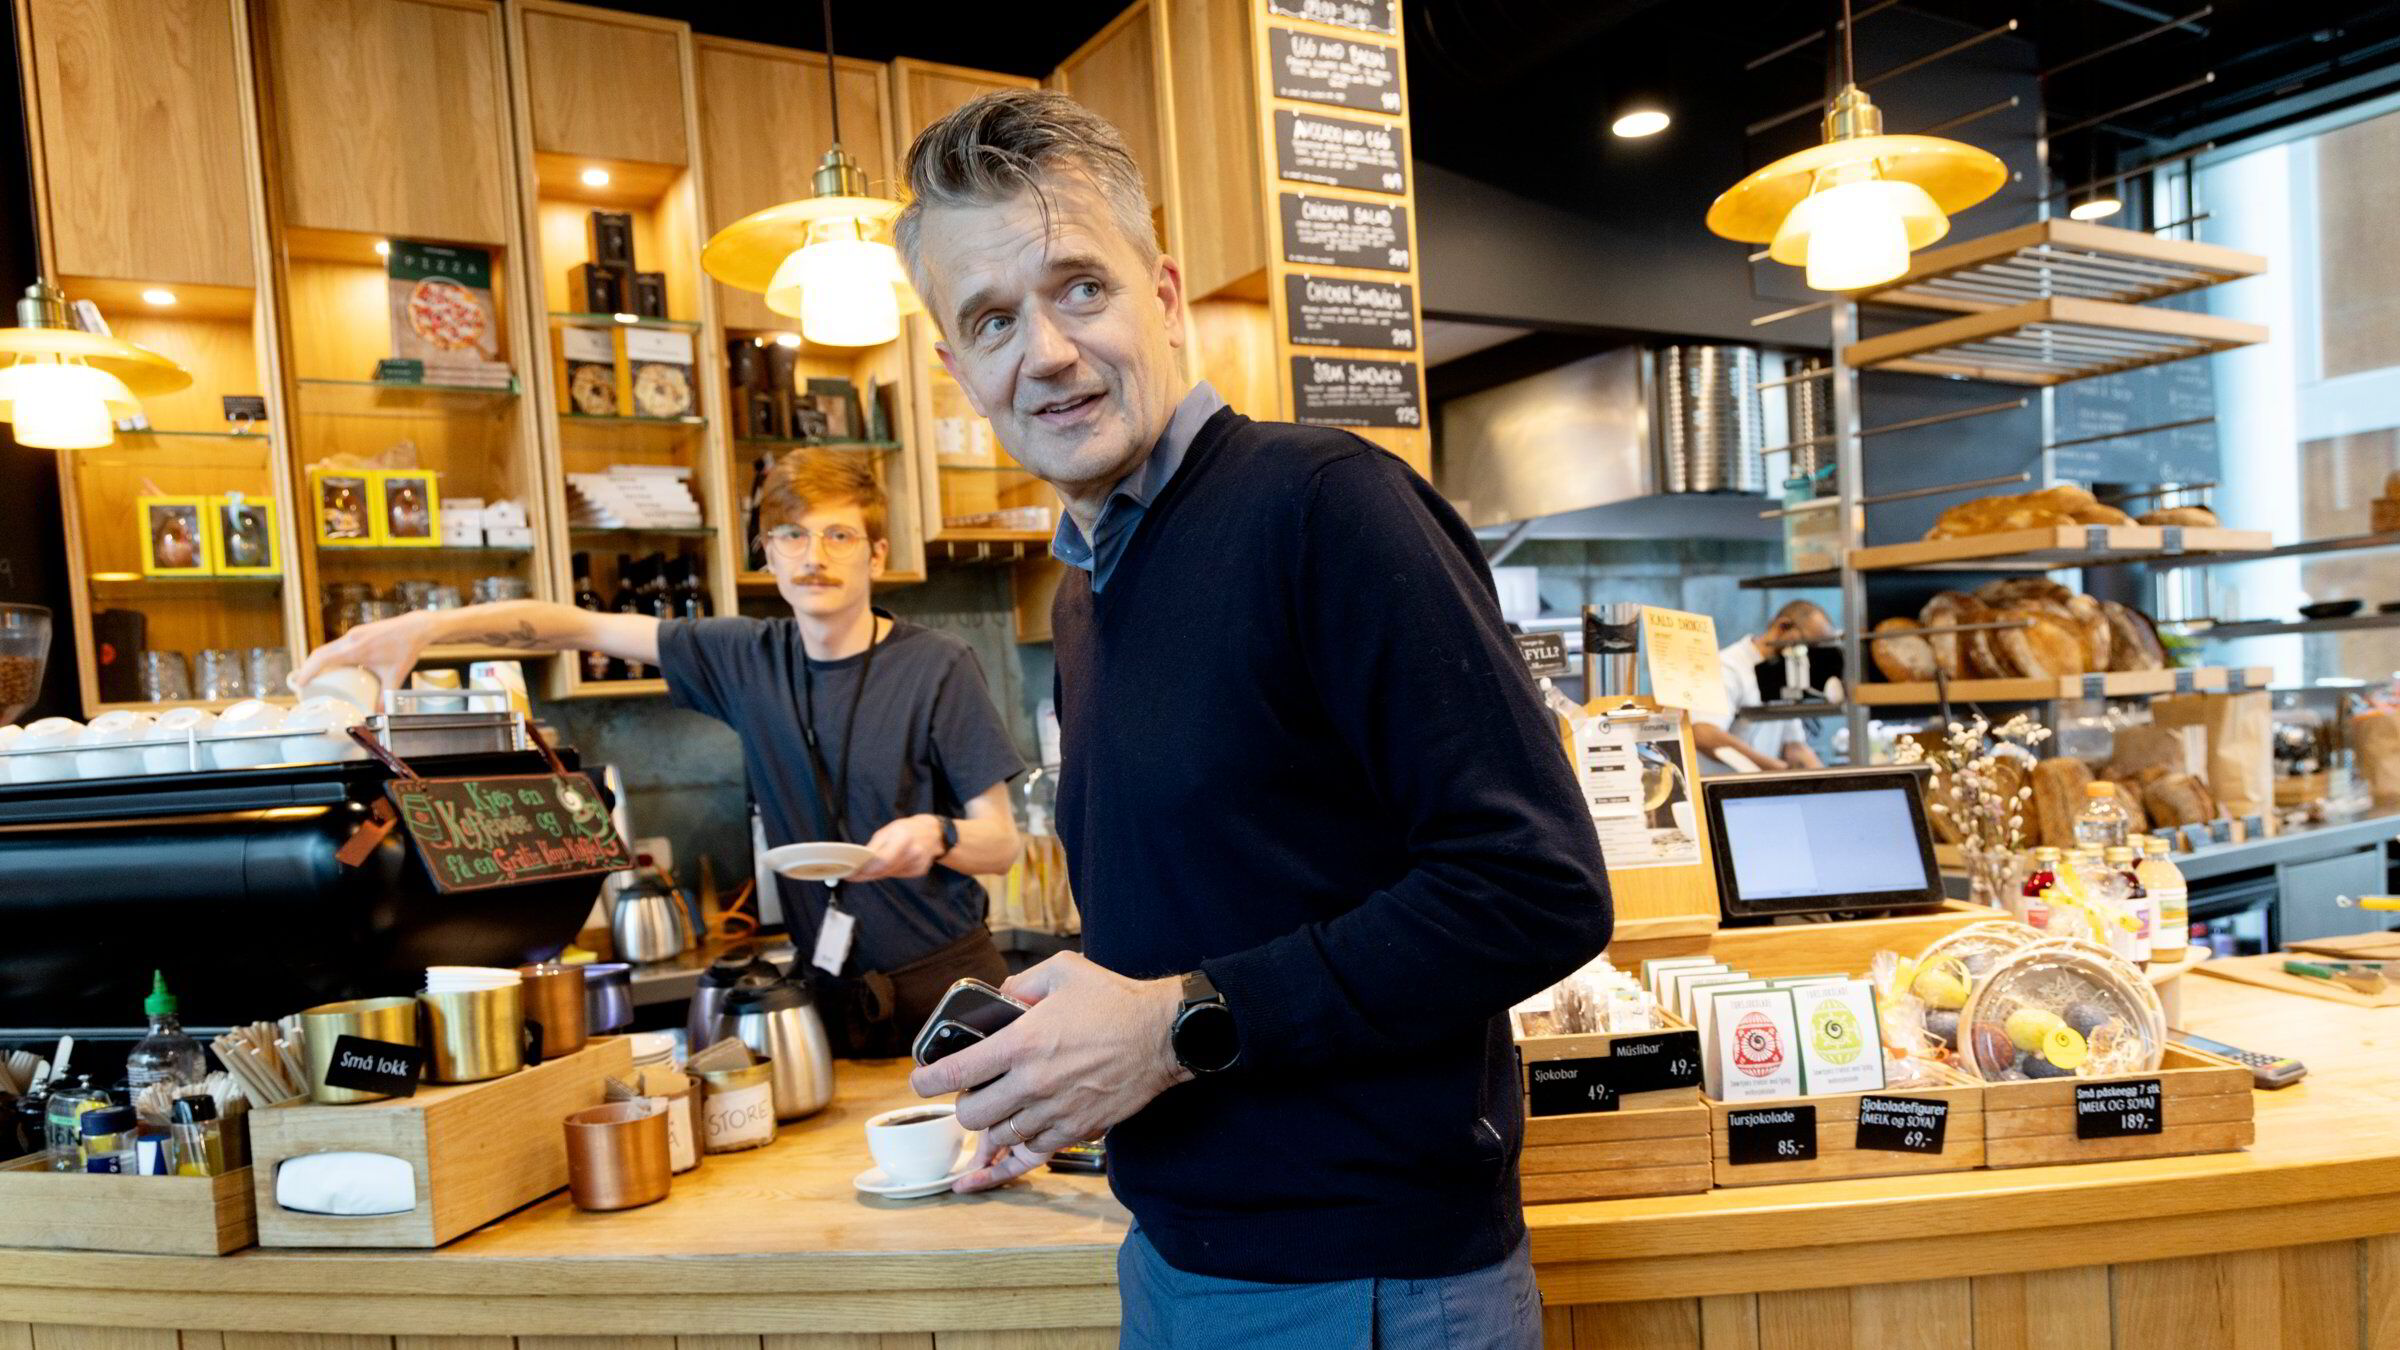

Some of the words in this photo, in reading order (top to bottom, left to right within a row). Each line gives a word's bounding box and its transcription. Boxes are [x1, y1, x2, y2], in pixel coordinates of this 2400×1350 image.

[464, 782, 513, 816] Kjøp
[518, 789, 544, 805] en
[536, 812, 563, 837] og
[447, 854, 474, 882] få
[474, 856, 497, 874] en
[1616, 1043, 1660, 1056] Müslibar
[341, 1051, 373, 1070] Små
[377, 1057, 408, 1076] lokk
[1535, 1069, 1578, 1083] Sjokobar
[2077, 1088, 2094, 1098] Små
[2139, 1084, 2145, 1094] 7
[2147, 1084, 2160, 1094] stk
[1862, 1098, 1947, 1116] Sjokoladefigurer
[2079, 1101, 2107, 1114] (MELK
[2108, 1100, 2125, 1111] OG
[2127, 1096, 2155, 1109] SOYA)
[708, 1100, 769, 1136] STORE
[1729, 1112, 1795, 1127] Tursjokolade
[1861, 1113, 1889, 1126] (MELK
[1891, 1116, 1904, 1128] og
[1907, 1116, 1935, 1129] SOYA)
